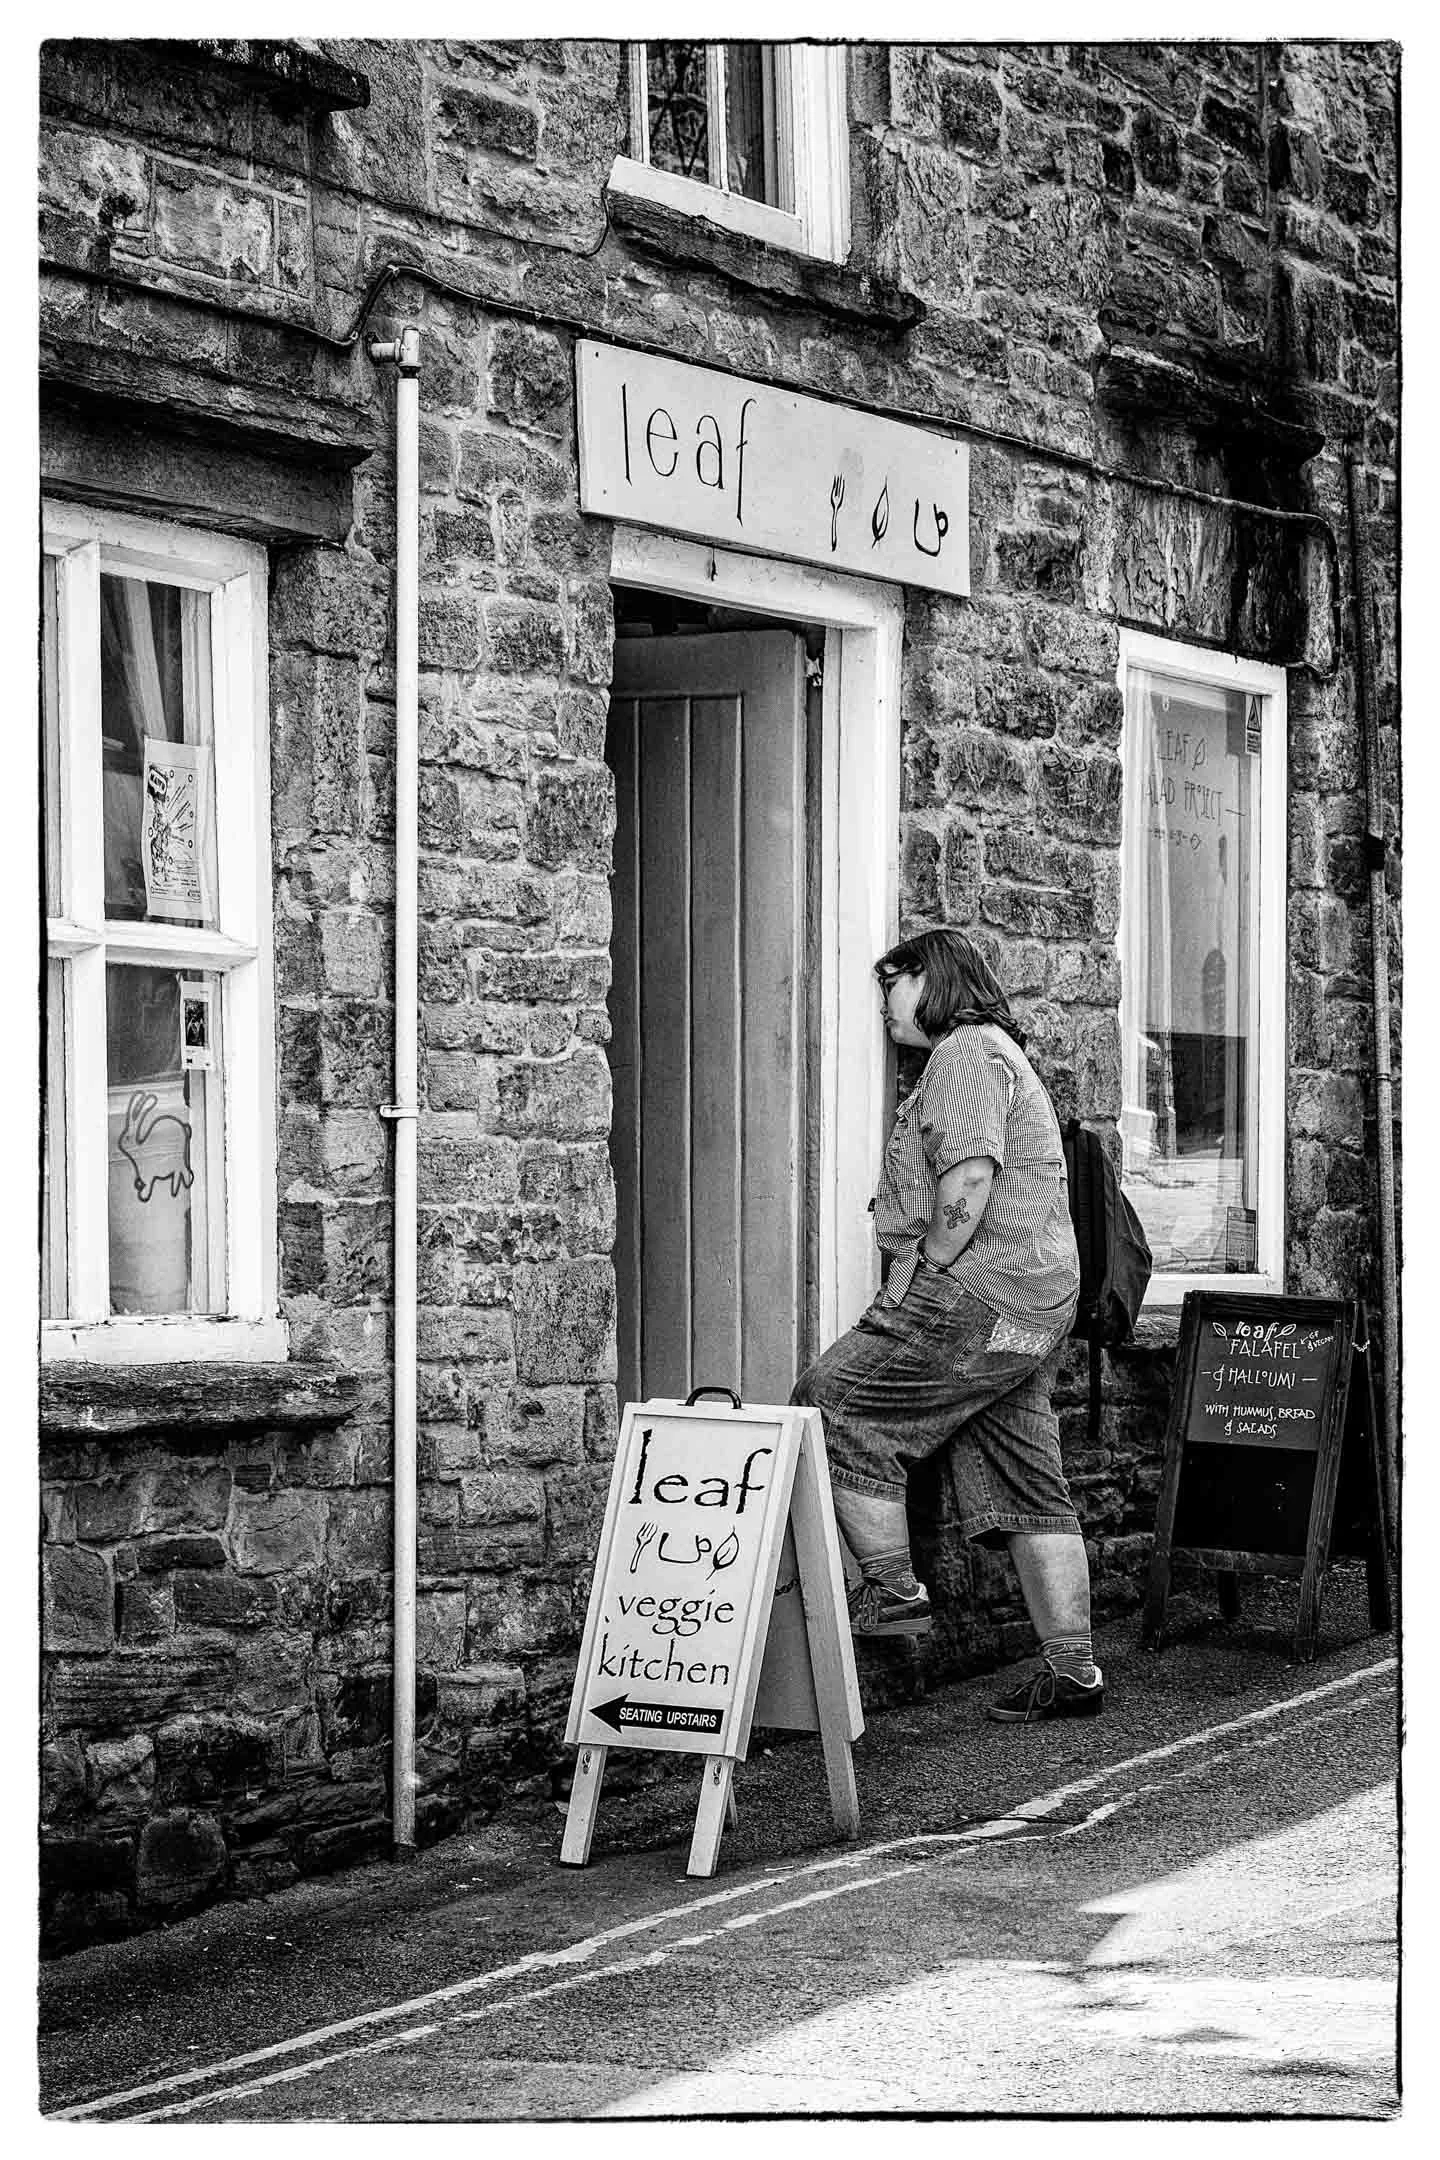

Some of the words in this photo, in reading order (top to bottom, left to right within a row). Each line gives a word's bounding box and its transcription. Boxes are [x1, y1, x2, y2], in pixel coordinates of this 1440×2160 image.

[621, 383, 758, 527] leaf
[1229, 1338, 1301, 1360] FALAFEL
[1237, 1422, 1277, 1438] SALADS
[1278, 1407, 1316, 1420] BREAD
[628, 1428, 774, 1515] leaf
[617, 1588, 736, 1637] veggie
[596, 1631, 731, 1686] kitchen
[618, 1706, 663, 1724] SEATING
[665, 1710, 718, 1729] UPSTAIRS
